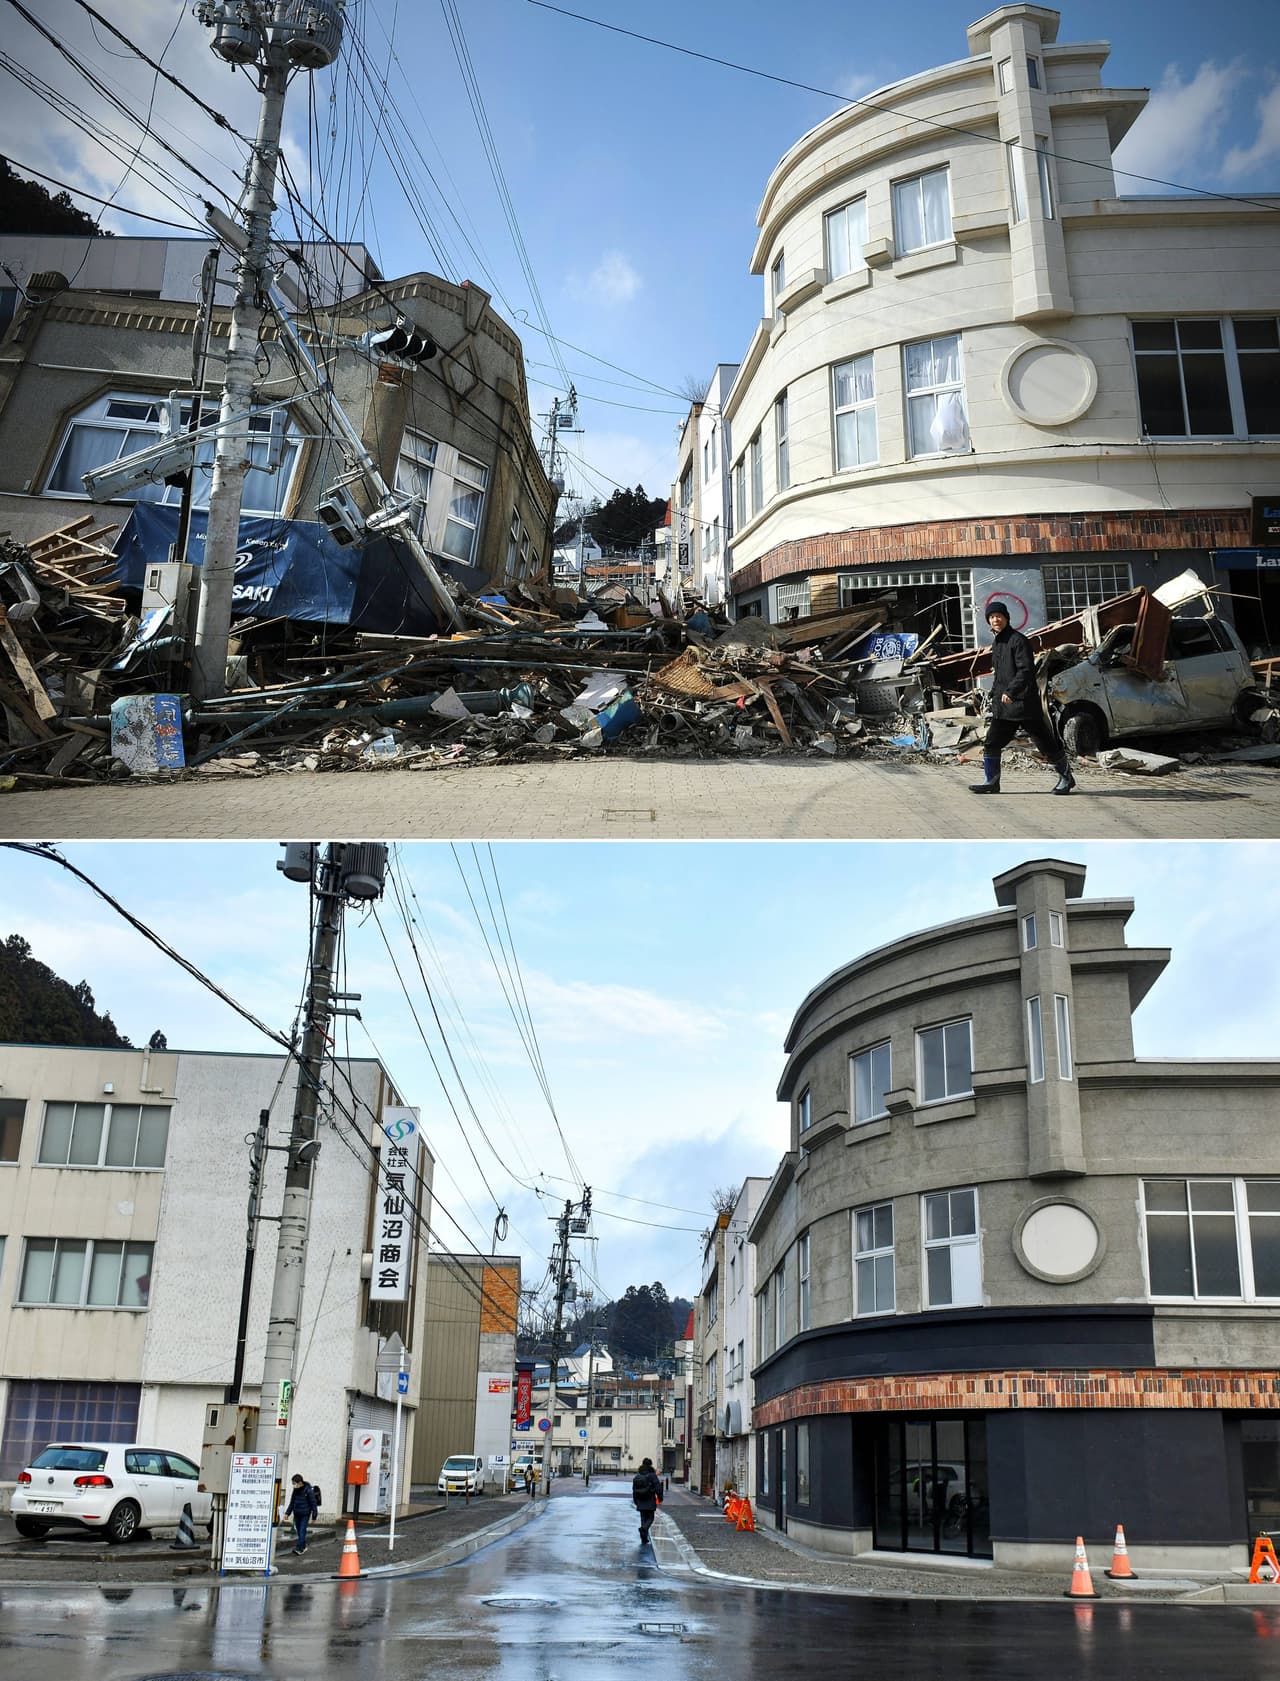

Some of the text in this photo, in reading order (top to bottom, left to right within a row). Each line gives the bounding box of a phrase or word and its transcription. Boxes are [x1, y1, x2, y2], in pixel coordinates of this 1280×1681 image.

[1256, 556, 1280, 567] La
[378, 1172, 405, 1288] 気仙沼商会
[234, 1457, 272, 1466] 工事中
